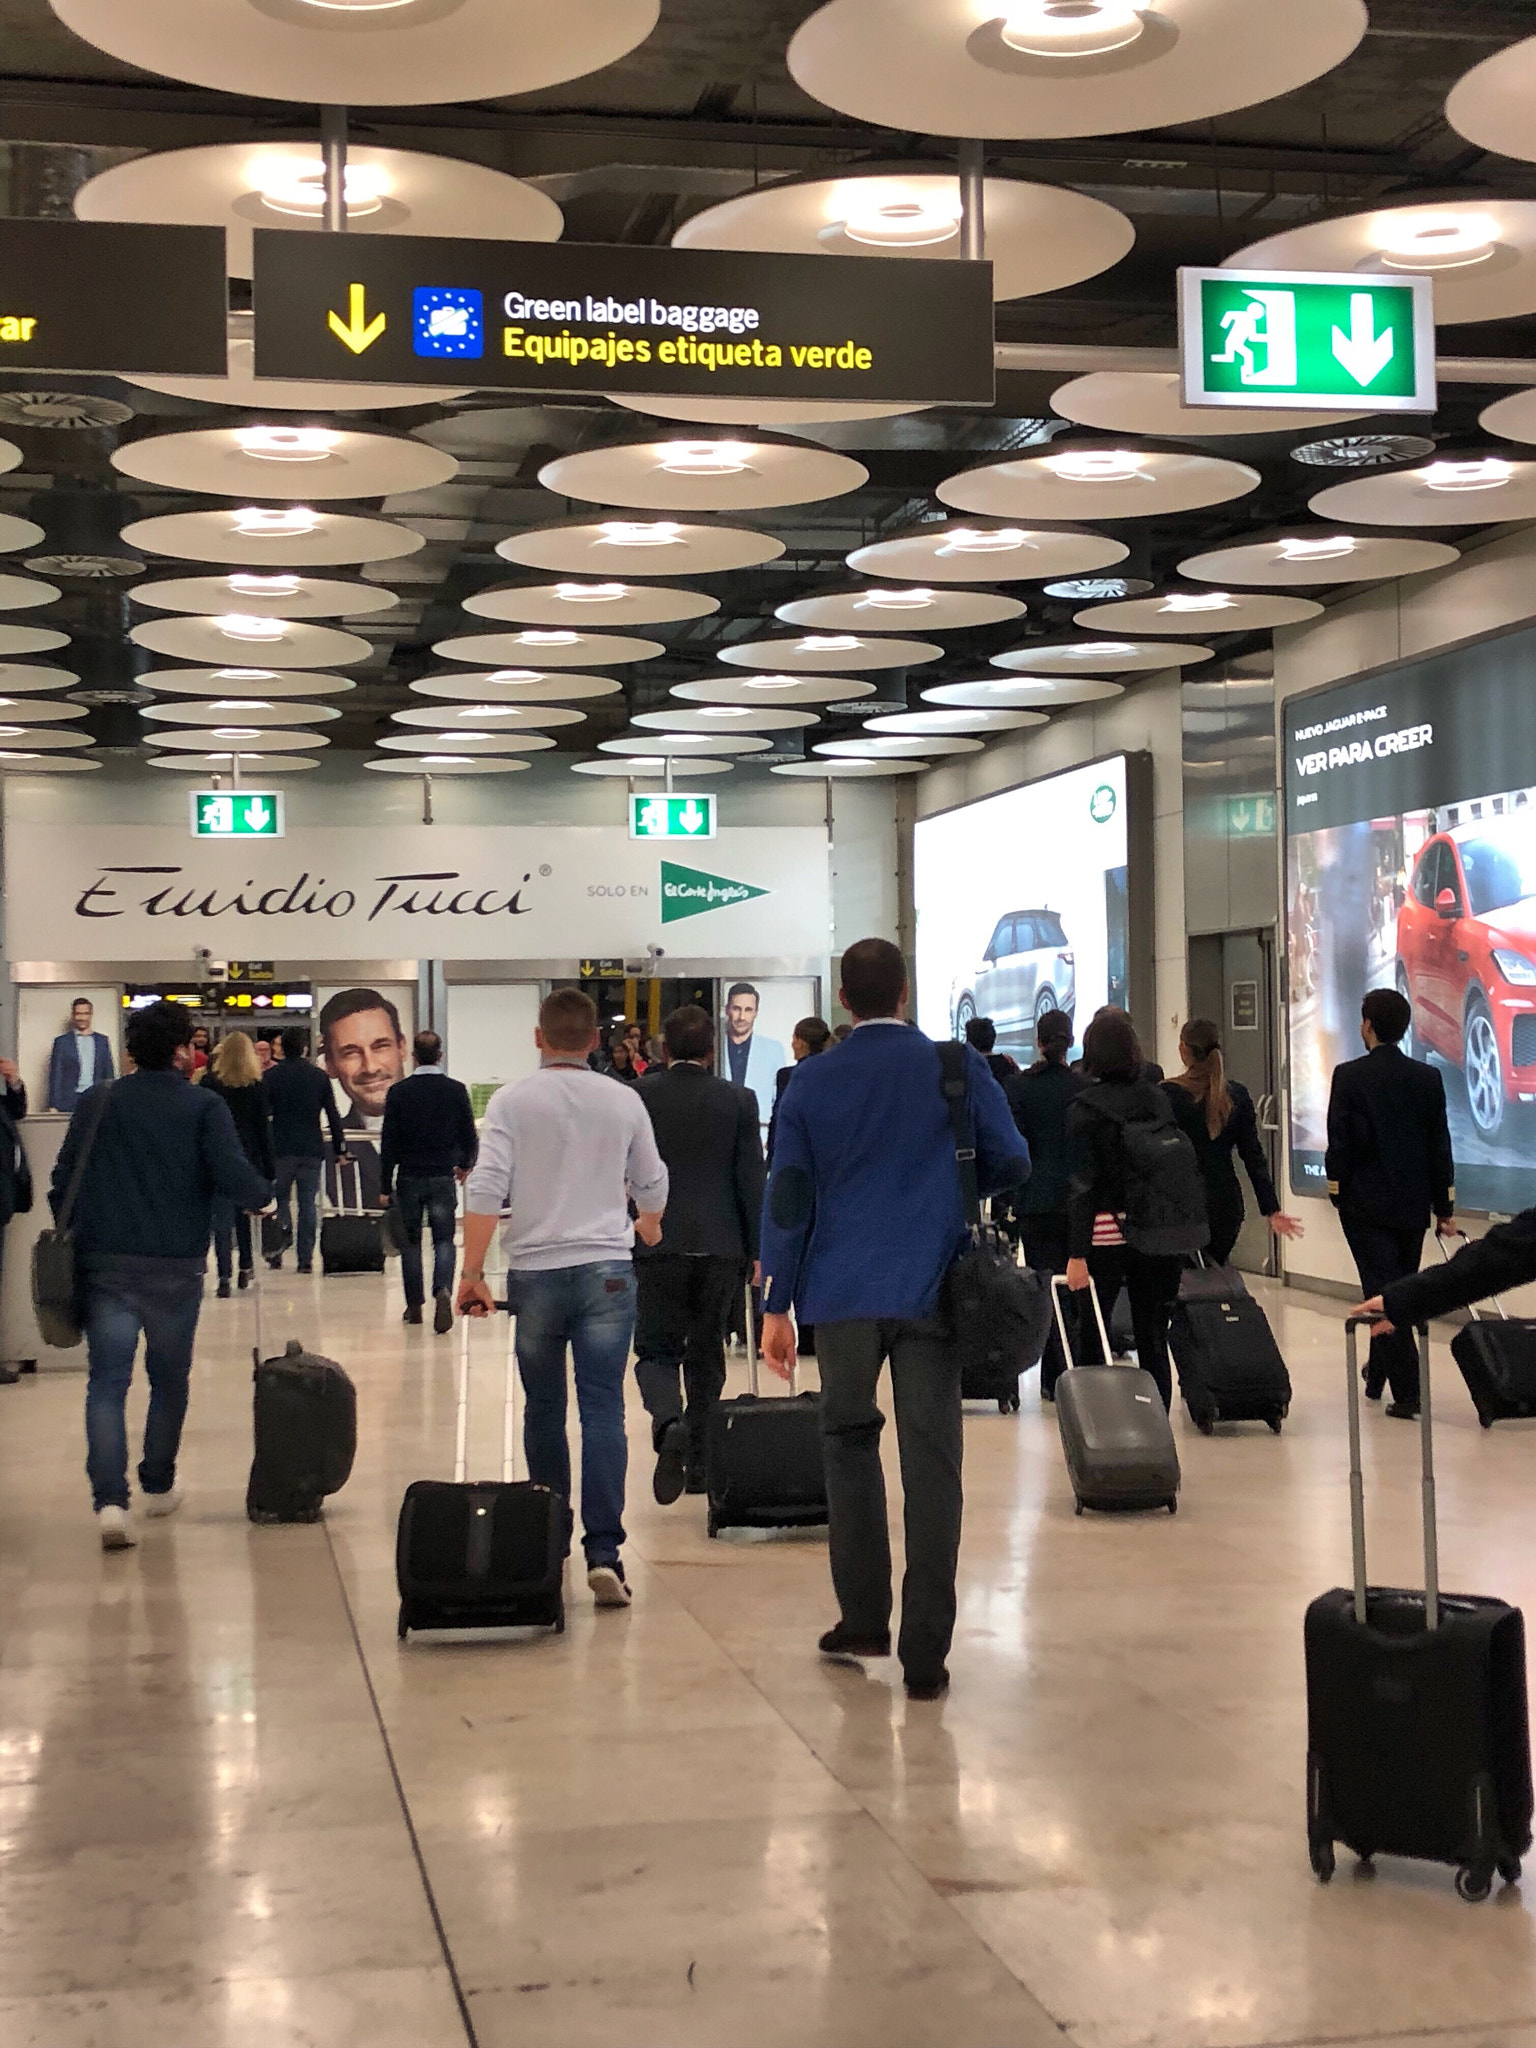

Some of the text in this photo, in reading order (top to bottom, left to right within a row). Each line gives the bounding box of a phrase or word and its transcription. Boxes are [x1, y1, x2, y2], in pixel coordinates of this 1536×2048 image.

[504, 291, 759, 334] Green label baggage
[503, 326, 873, 371] Equipajes etiqueta verde
[1295, 723, 1323, 741] NUEVO
[1323, 713, 1357, 734] JAGUAR
[1295, 723, 1433, 777] VER PARA CREER
[587, 885, 649, 898] SOLO EN
